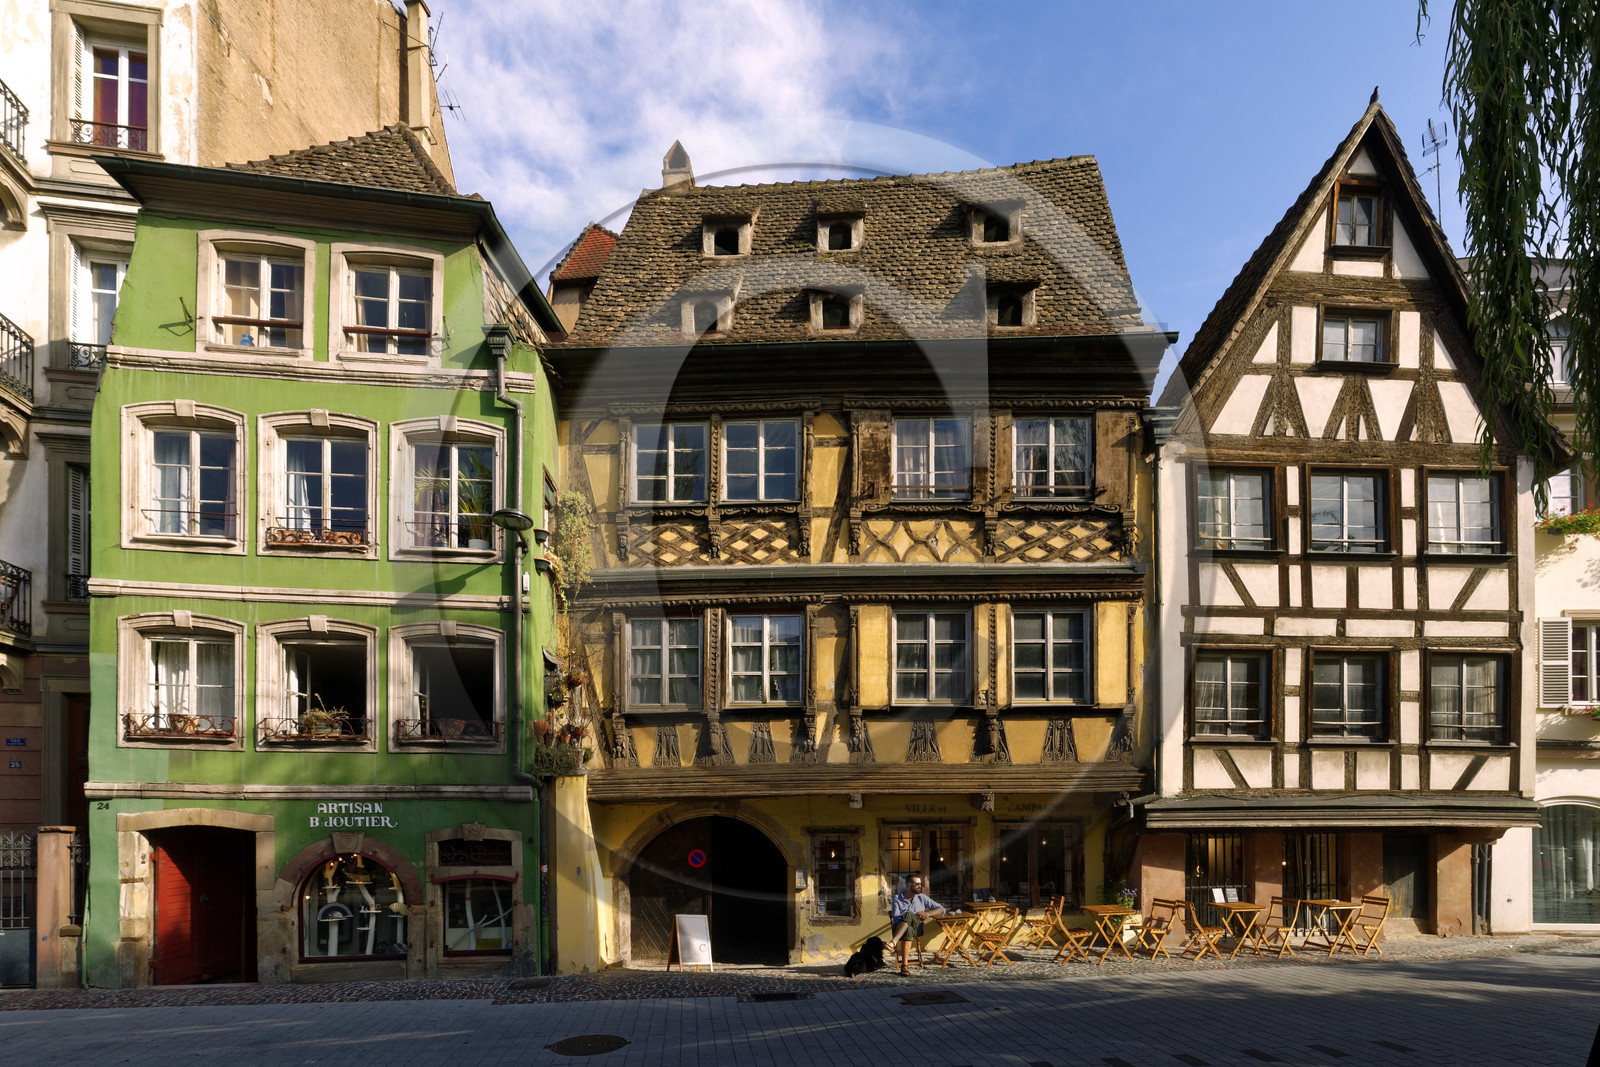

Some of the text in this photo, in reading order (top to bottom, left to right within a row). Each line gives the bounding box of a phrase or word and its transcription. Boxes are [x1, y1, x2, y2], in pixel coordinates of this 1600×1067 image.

[97, 802, 110, 811] 24
[317, 802, 384, 814] ARTISAN
[905, 802, 1066, 814] VILLE et CAMPAGNE
[309, 816, 398, 829] BJOUTIER
